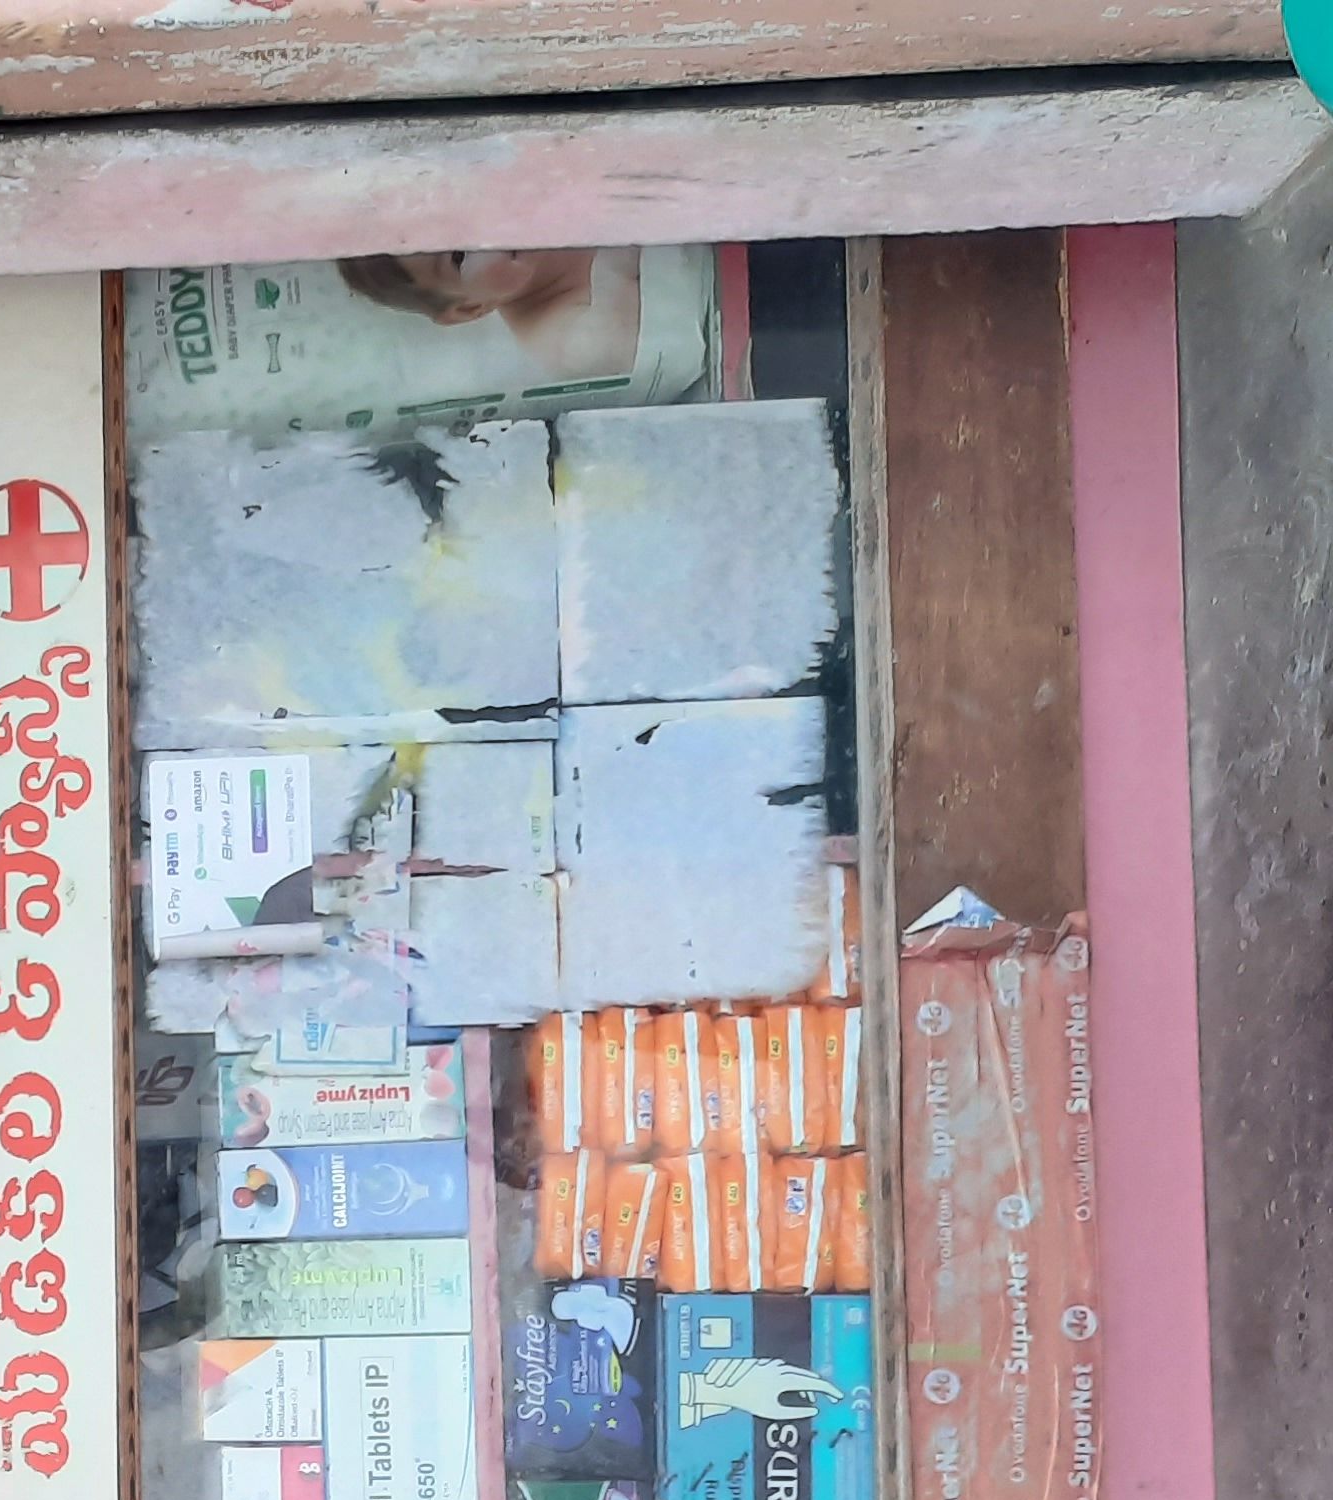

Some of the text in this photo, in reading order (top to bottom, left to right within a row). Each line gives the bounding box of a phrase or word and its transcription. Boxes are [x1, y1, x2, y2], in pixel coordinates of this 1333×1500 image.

[155, 298, 168, 335] EASY
[224, 287, 240, 360] BABY DIAPER
[193, 770, 203, 812] amazon
[221, 816, 233, 860] BHIM
[167, 888, 181, 909] Pay
[167, 912, 181, 924] G
[315, 1082, 411, 1104] Lupizyme
[331, 1153, 348, 1228] CALCIJOINT
[1065, 1309, 1093, 1338] 4G
[275, 1360, 285, 1388] Tablets
[365, 1363, 390, 1388] IP
[514, 1314, 553, 1425] Stayfree
[367, 1396, 392, 1486] Tablets
[1066, 1363, 1095, 1489] SuperNet
